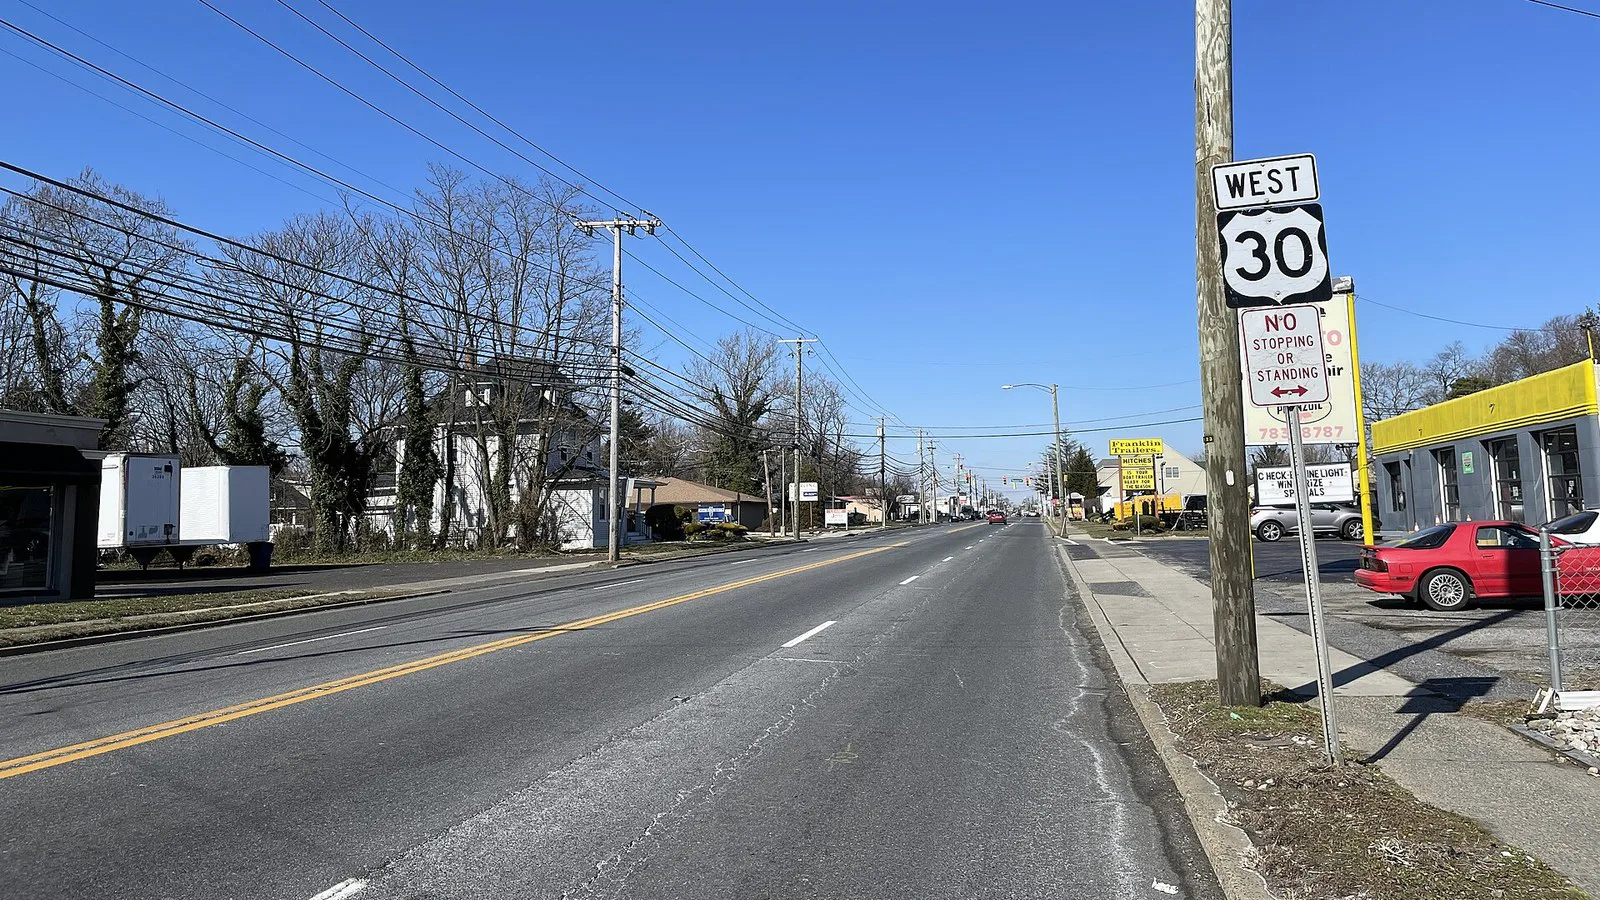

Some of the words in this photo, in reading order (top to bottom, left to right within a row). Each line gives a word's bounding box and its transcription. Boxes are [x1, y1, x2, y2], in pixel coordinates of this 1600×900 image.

[1225, 166, 1300, 198] WEST
[1234, 226, 1314, 281] 30
[1264, 312, 1296, 332] NO
[1253, 335, 1314, 350] STOPPING
[1277, 352, 1294, 364] OR
[1257, 367, 1318, 382] STANDING
